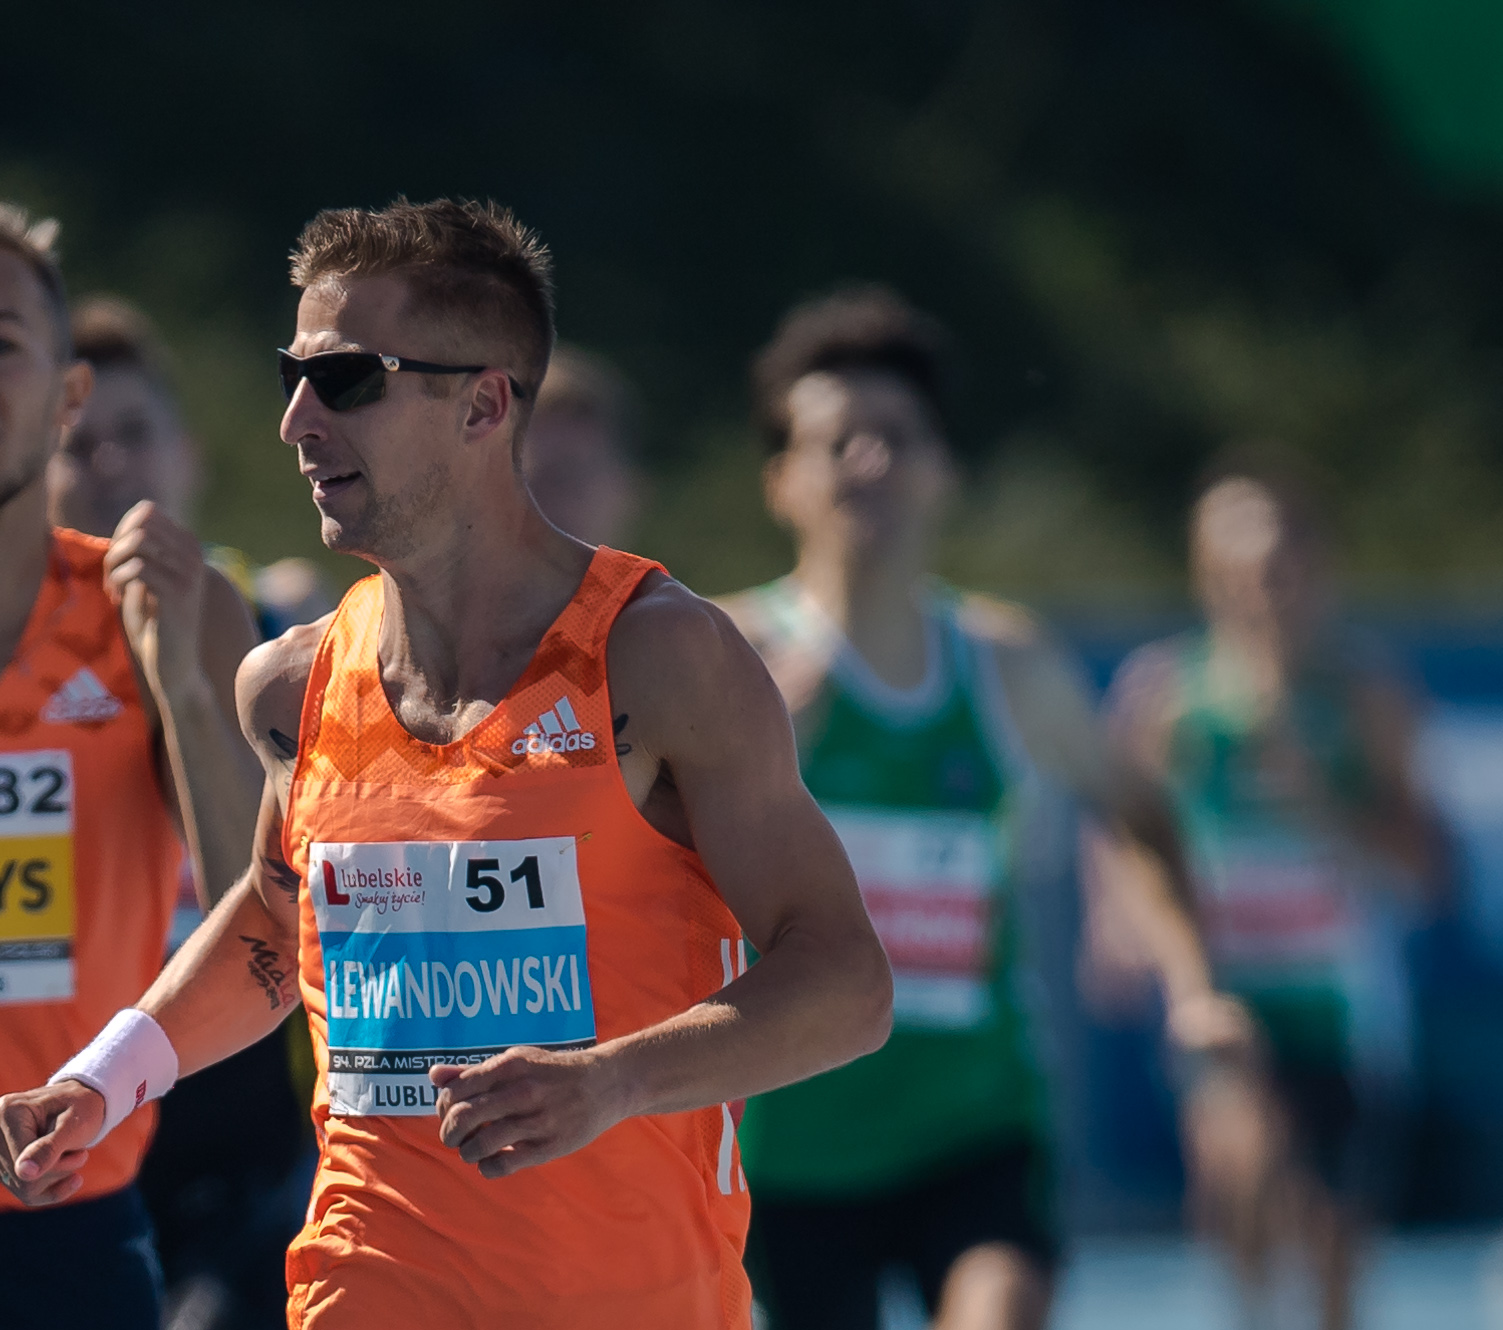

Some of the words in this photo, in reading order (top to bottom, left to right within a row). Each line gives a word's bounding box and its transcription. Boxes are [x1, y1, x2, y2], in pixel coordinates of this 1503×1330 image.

[511, 732, 596, 755] adidas
[465, 855, 545, 913] 51
[330, 954, 581, 1019] LEWANDOWSKI
[333, 1054, 353, 1069] 94.
[354, 1054, 391, 1069] PZLA
[375, 1084, 439, 1107] LUBLI
